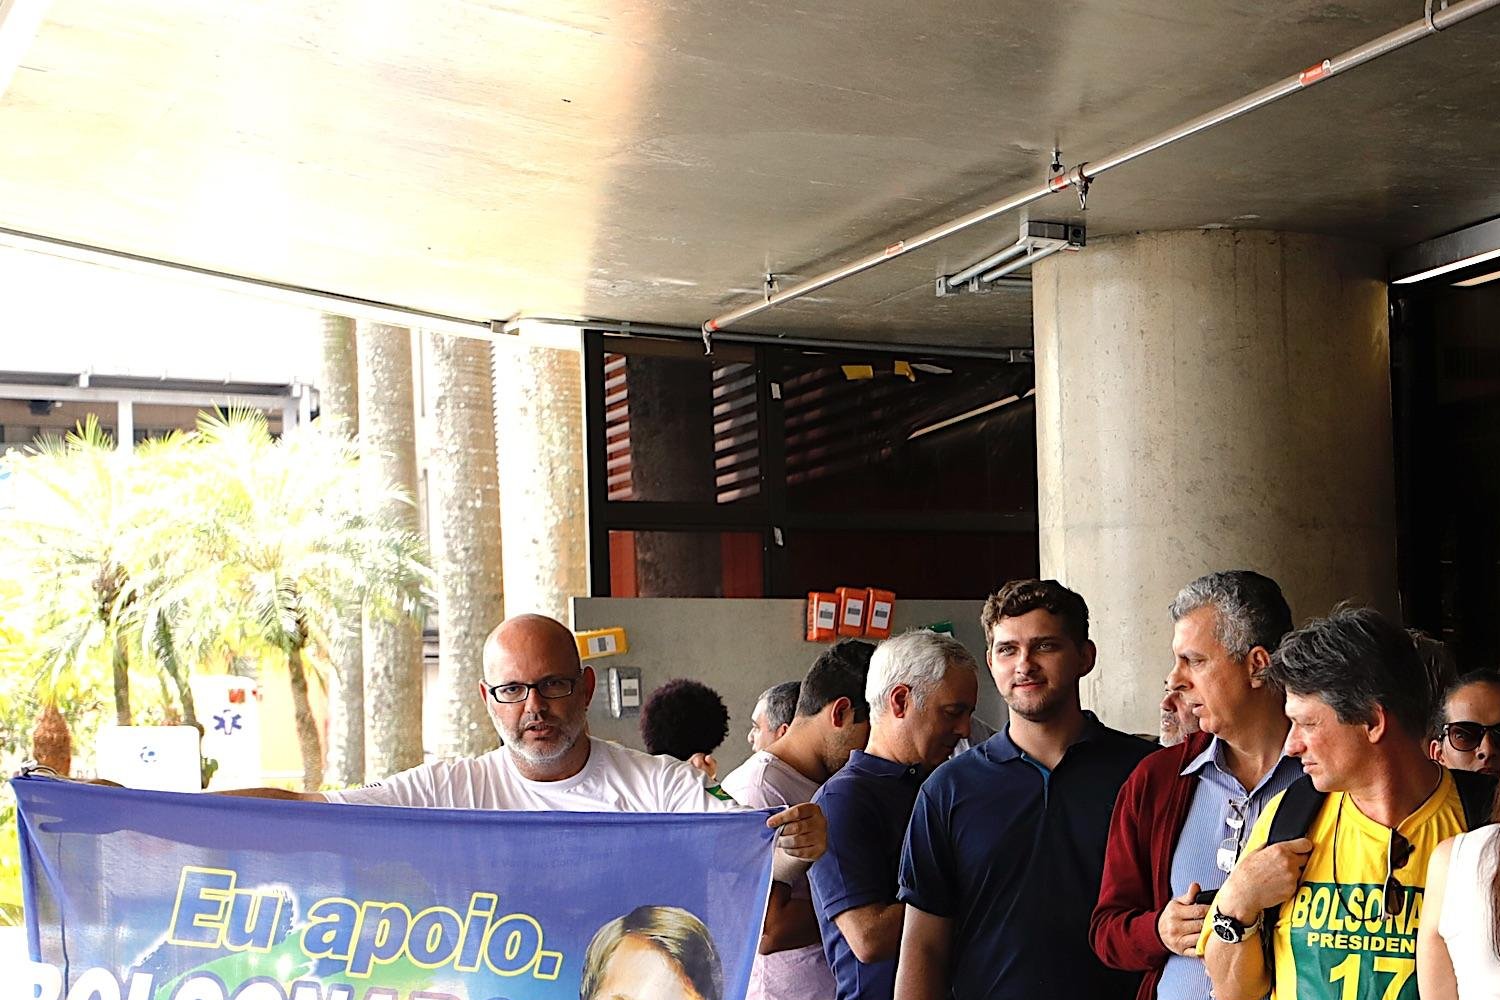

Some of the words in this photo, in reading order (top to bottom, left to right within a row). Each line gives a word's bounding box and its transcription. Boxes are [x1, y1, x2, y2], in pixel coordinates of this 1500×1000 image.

[168, 865, 284, 953] Eu
[301, 892, 563, 981] apoio.
[1307, 931, 1415, 954] PRESIDEN
